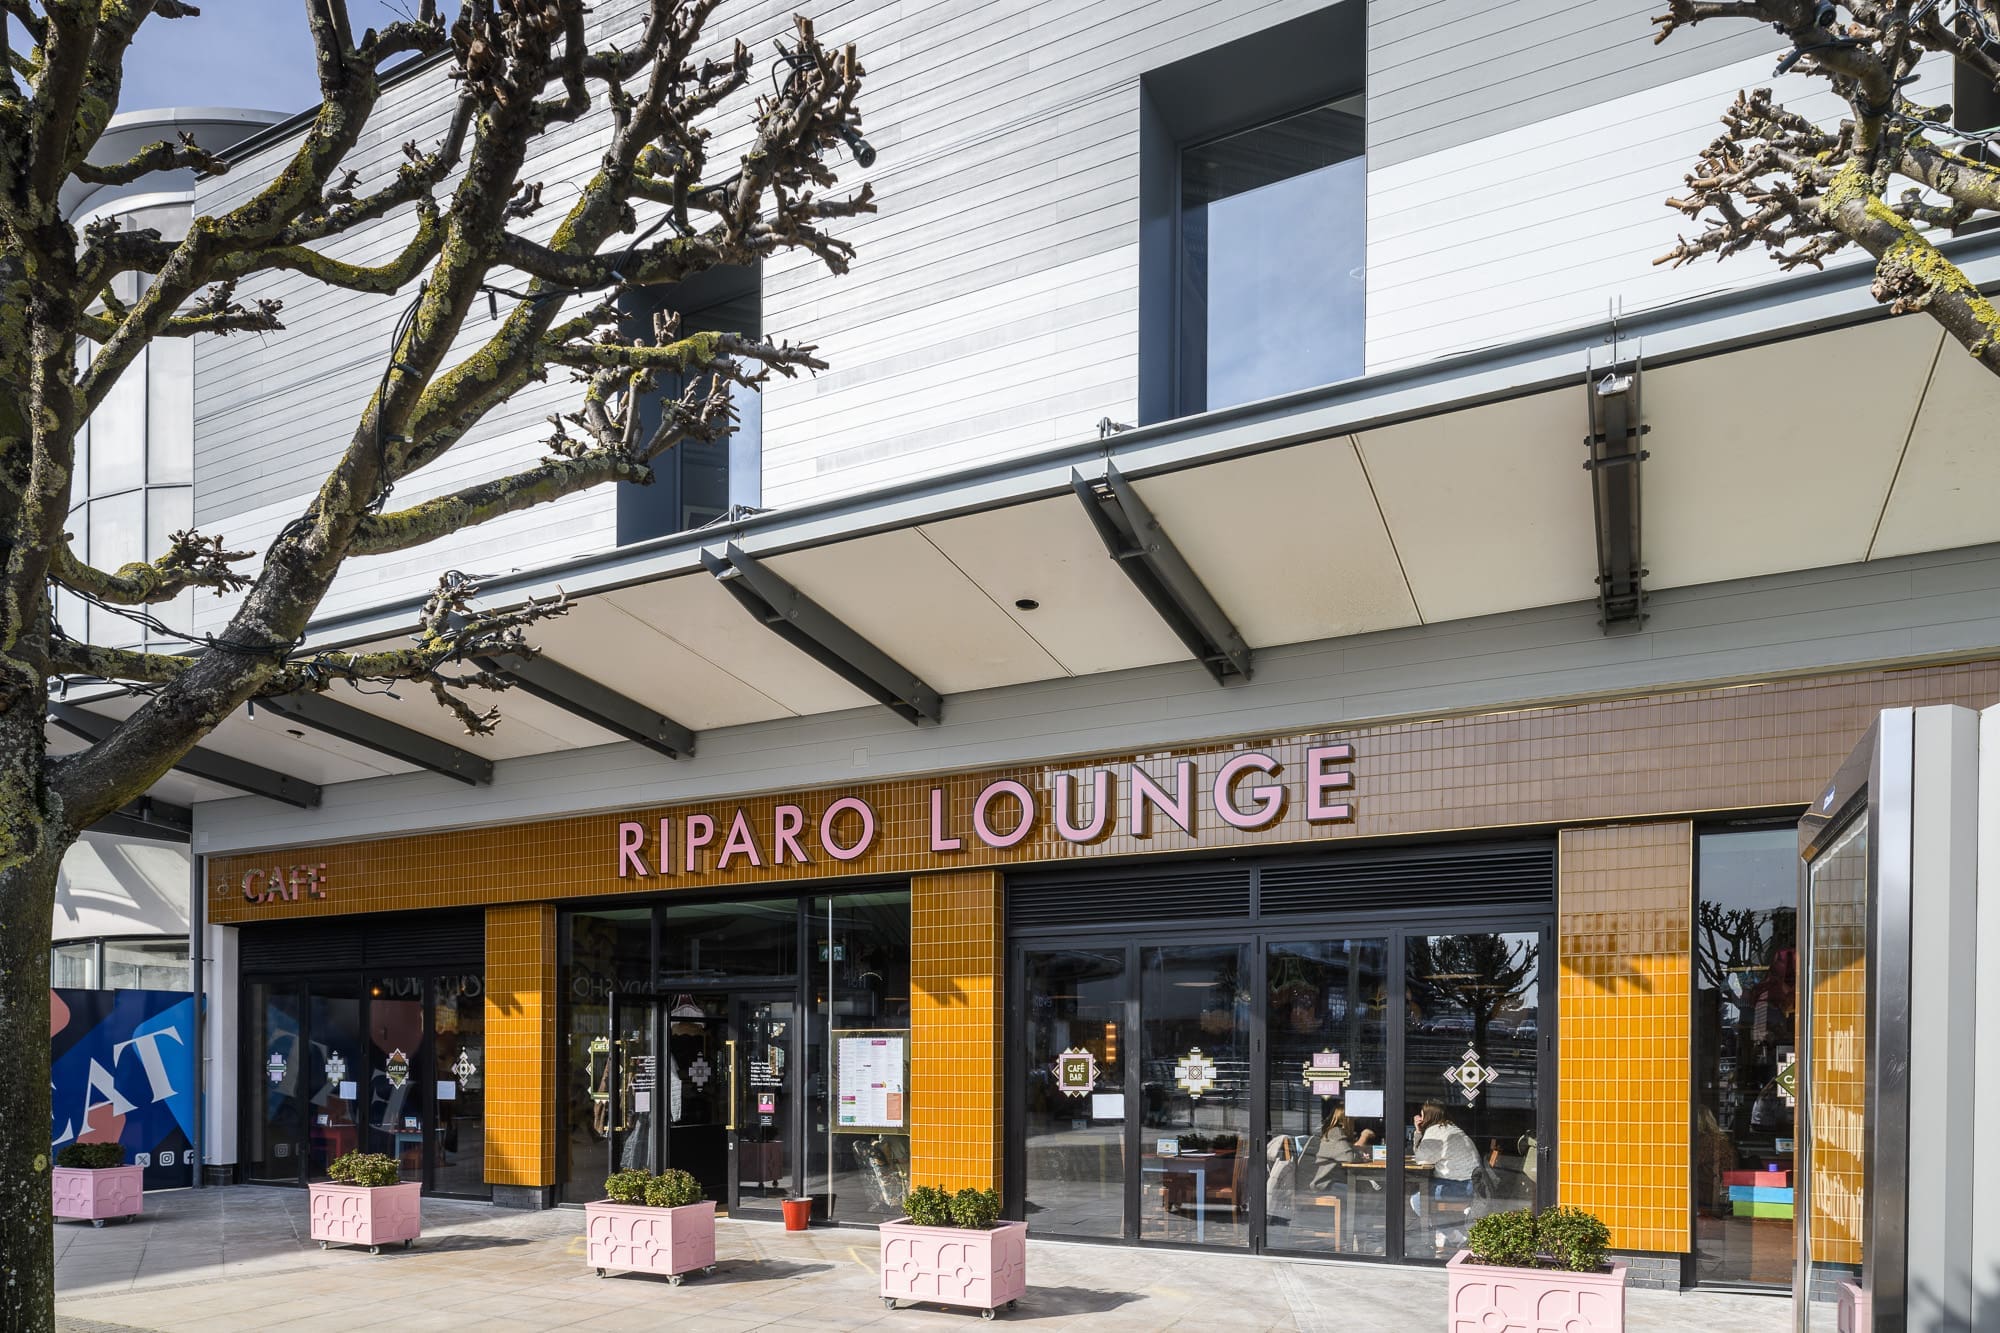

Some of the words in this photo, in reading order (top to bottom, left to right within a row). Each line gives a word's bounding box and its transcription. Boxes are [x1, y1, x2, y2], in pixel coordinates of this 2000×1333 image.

[618, 797, 880, 878] RIPARO
[930, 743, 1356, 852] LOUNGE
[241, 862, 328, 905] CAFE
[1067, 1062, 1085, 1073] CAFÉ
[1069, 1073, 1083, 1081] BAR
